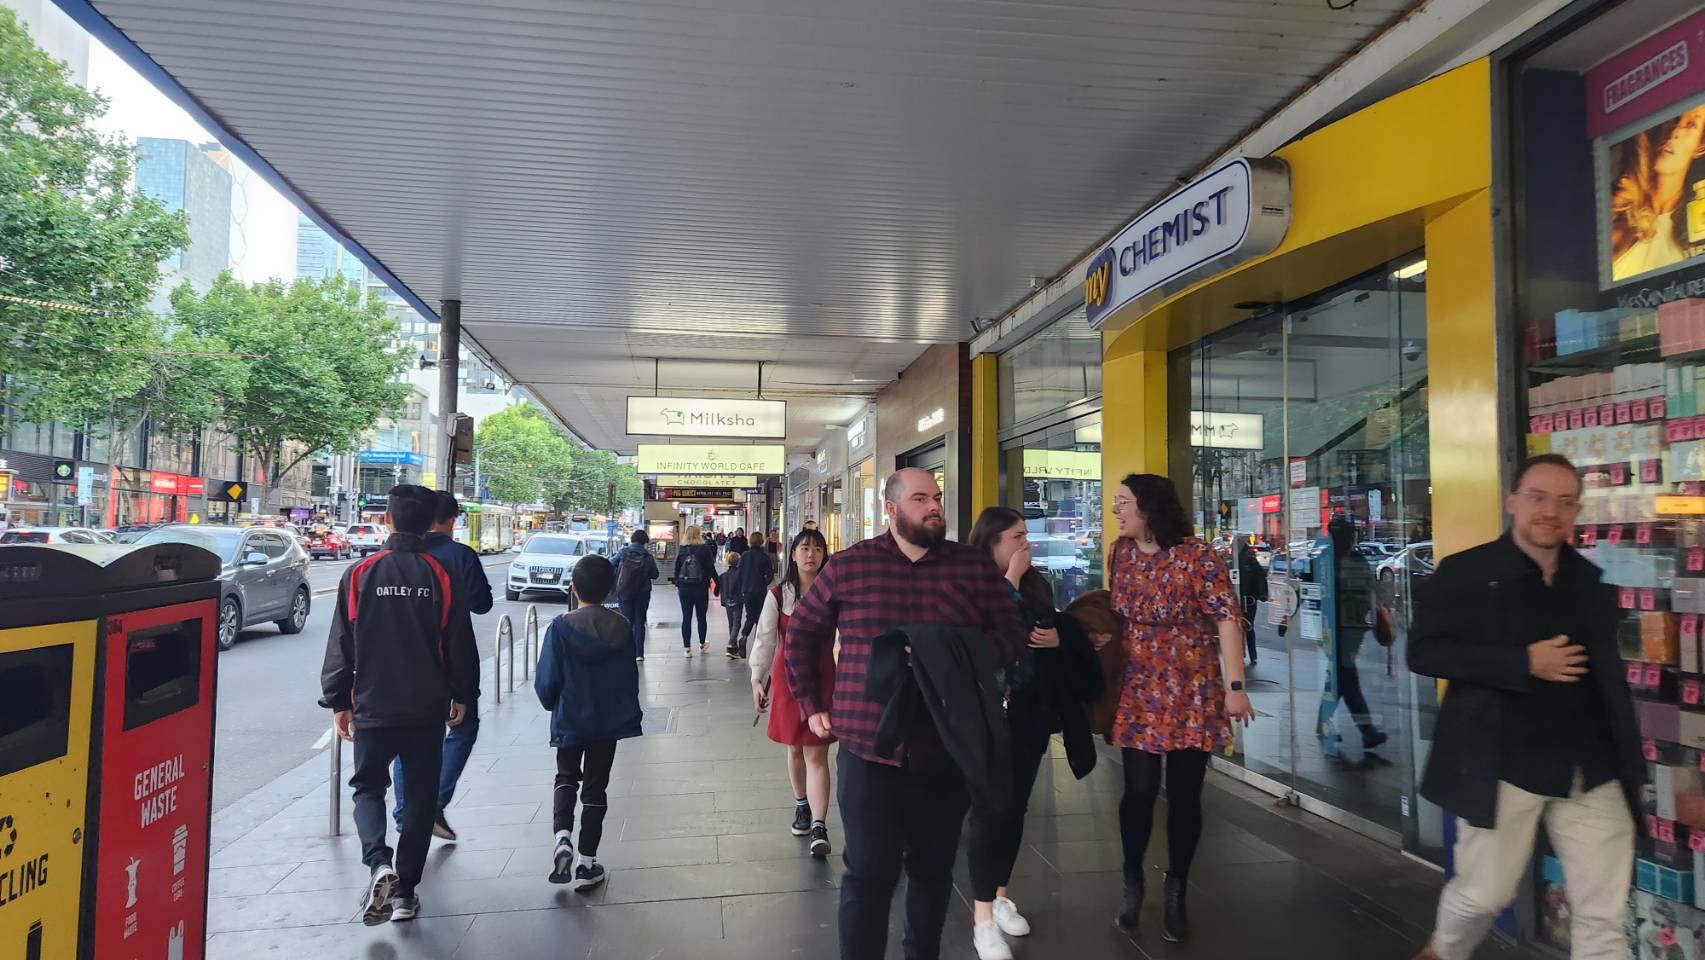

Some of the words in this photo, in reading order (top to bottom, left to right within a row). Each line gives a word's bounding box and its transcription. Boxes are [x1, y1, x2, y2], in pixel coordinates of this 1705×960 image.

[1607, 44, 1685, 108] FRAGRANCES
[1119, 186, 1234, 277] CHEMIST
[690, 412, 755, 427] Milksha
[656, 462, 699, 471] INFINITY
[701, 462, 737, 471] WORLD
[739, 462, 766, 471] CAFE
[376, 586, 412, 597] OATLEY
[417, 587, 430, 597] FC
[134, 753, 185, 801] GENERAL
[141, 785, 178, 829] WASTE
